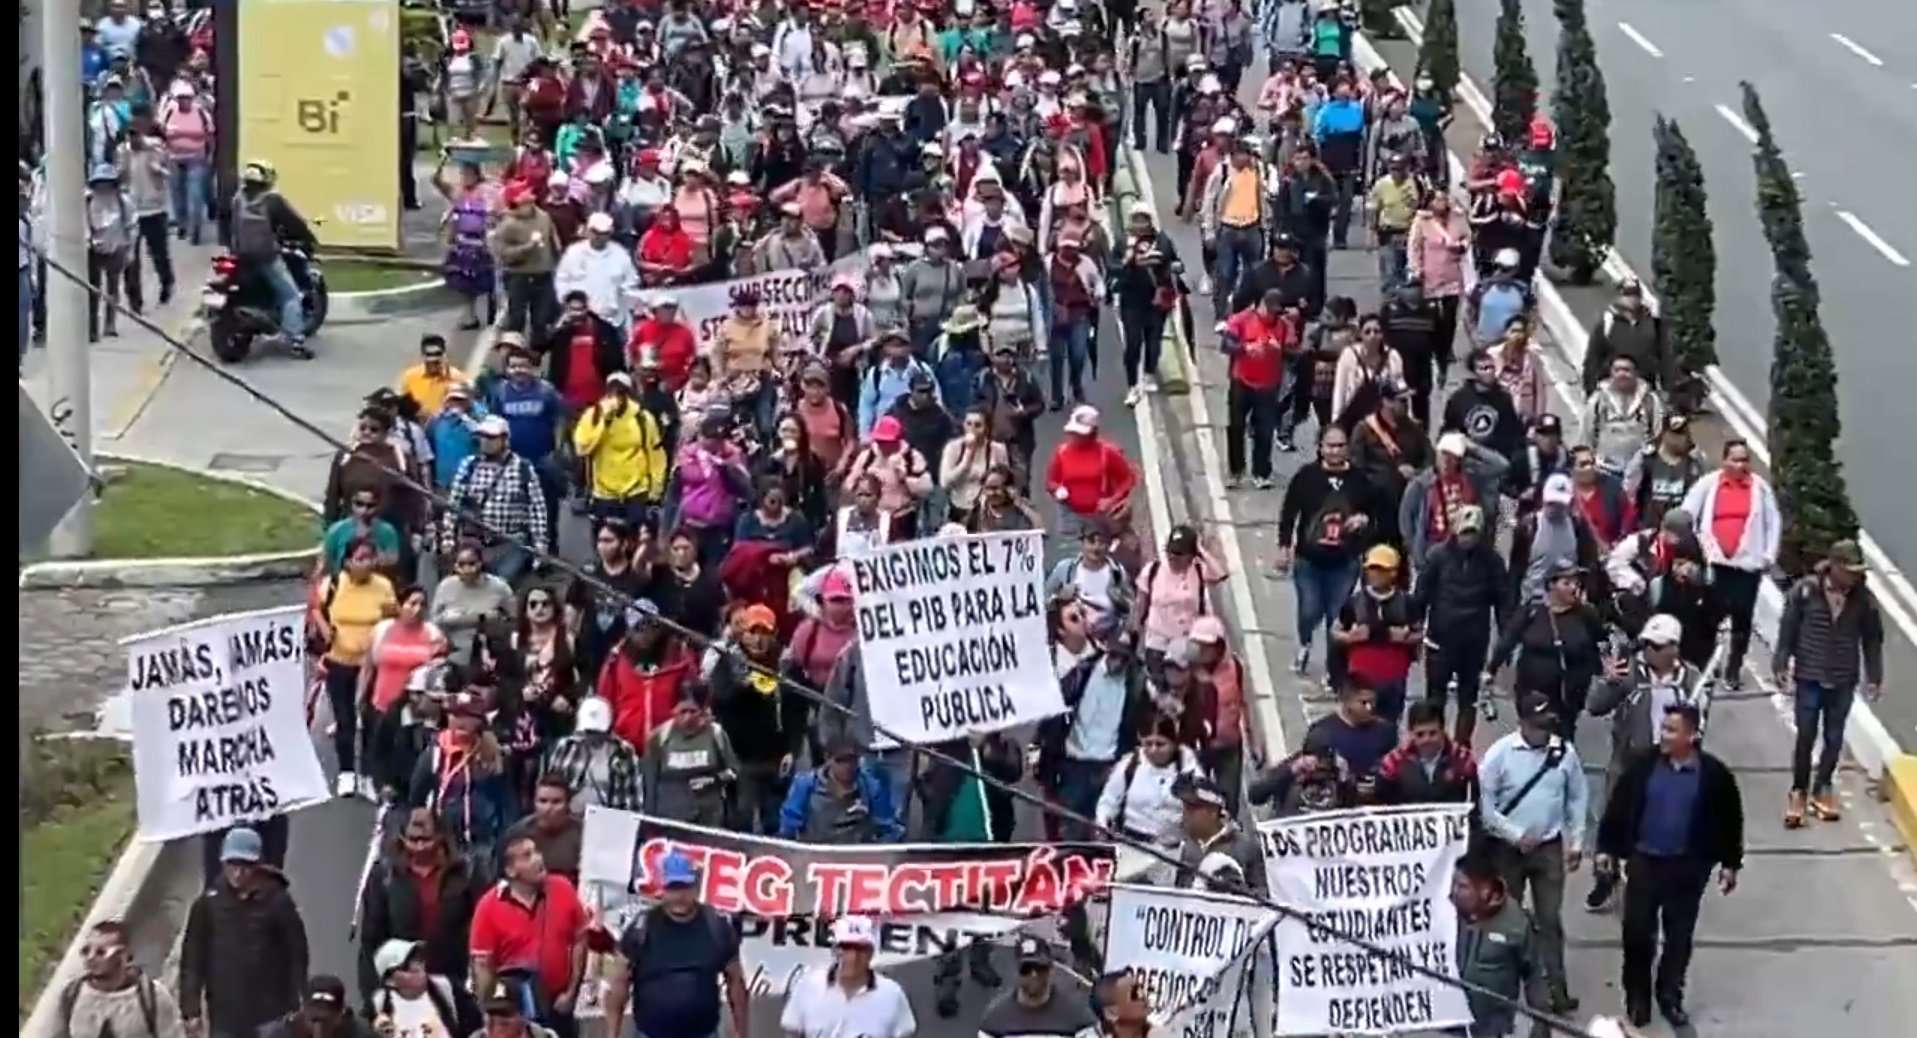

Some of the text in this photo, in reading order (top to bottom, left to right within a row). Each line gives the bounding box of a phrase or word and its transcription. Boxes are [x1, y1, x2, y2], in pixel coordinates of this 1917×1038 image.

[297, 94, 345, 133] Bi
[853, 538, 1035, 594] EXIGIMOS EL 7%
[859, 582, 1040, 642] DEL PIB PARA LA
[894, 626, 1019, 686] EDUCACIÓN
[920, 684, 1017, 731] PÚBLICA
[178, 726, 276, 777] MARCHA
[195, 771, 279, 822] ATRÁS
[1261, 828, 1302, 859] LOS
[1306, 815, 1437, 858] PROGRAMAS
[807, 846, 1114, 919] TECTITÁN
[1314, 862, 1426, 900] NUESTROS
[1136, 903, 1227, 960] "CONTROL
[1306, 898, 1432, 944] ESTUDIANTES
[1290, 954, 1316, 988] SE
[1321, 943, 1414, 989] RESPETAN
[1329, 990, 1433, 1030] DEFIENDEN
